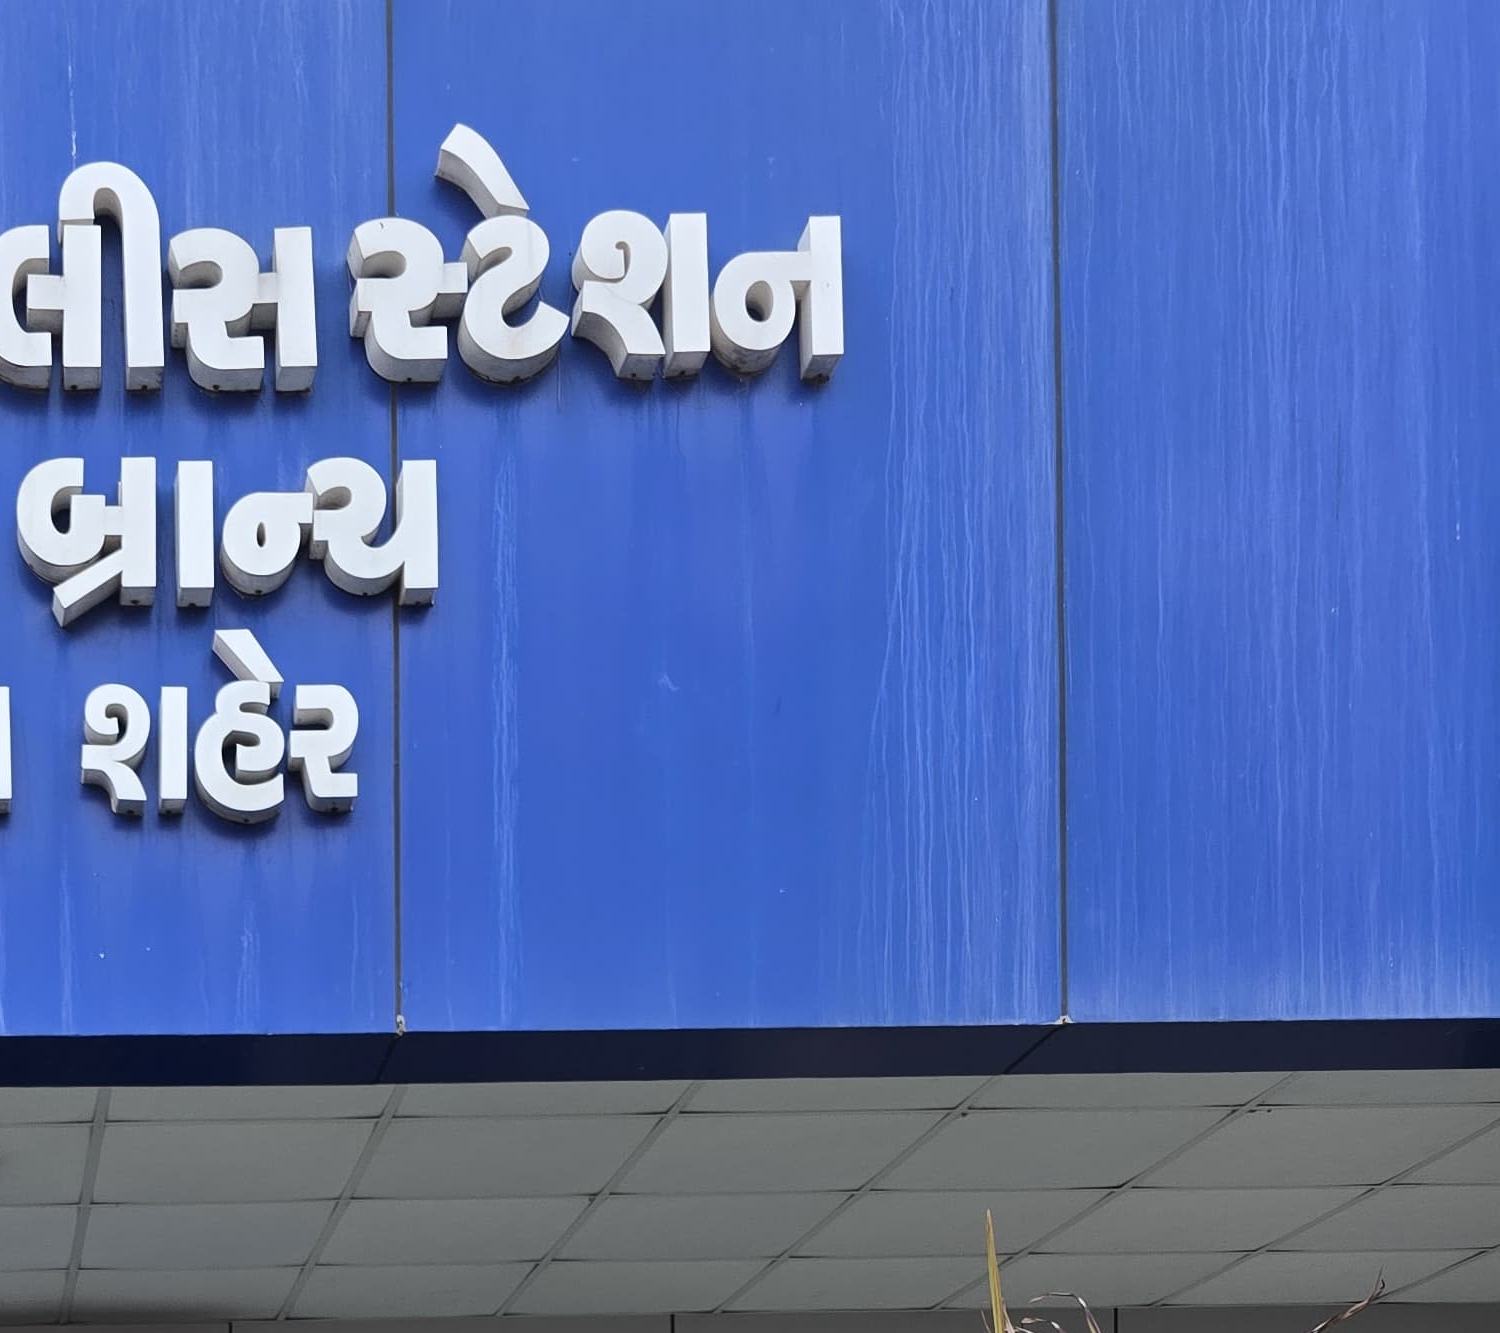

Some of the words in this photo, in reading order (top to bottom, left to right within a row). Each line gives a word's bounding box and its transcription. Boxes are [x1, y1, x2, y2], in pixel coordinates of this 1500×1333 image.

[348, 123, 844, 380] સ્ટેશન
[16, 456, 438, 627] બ્રાન્ચ
[80, 628, 358, 824] શહેર
